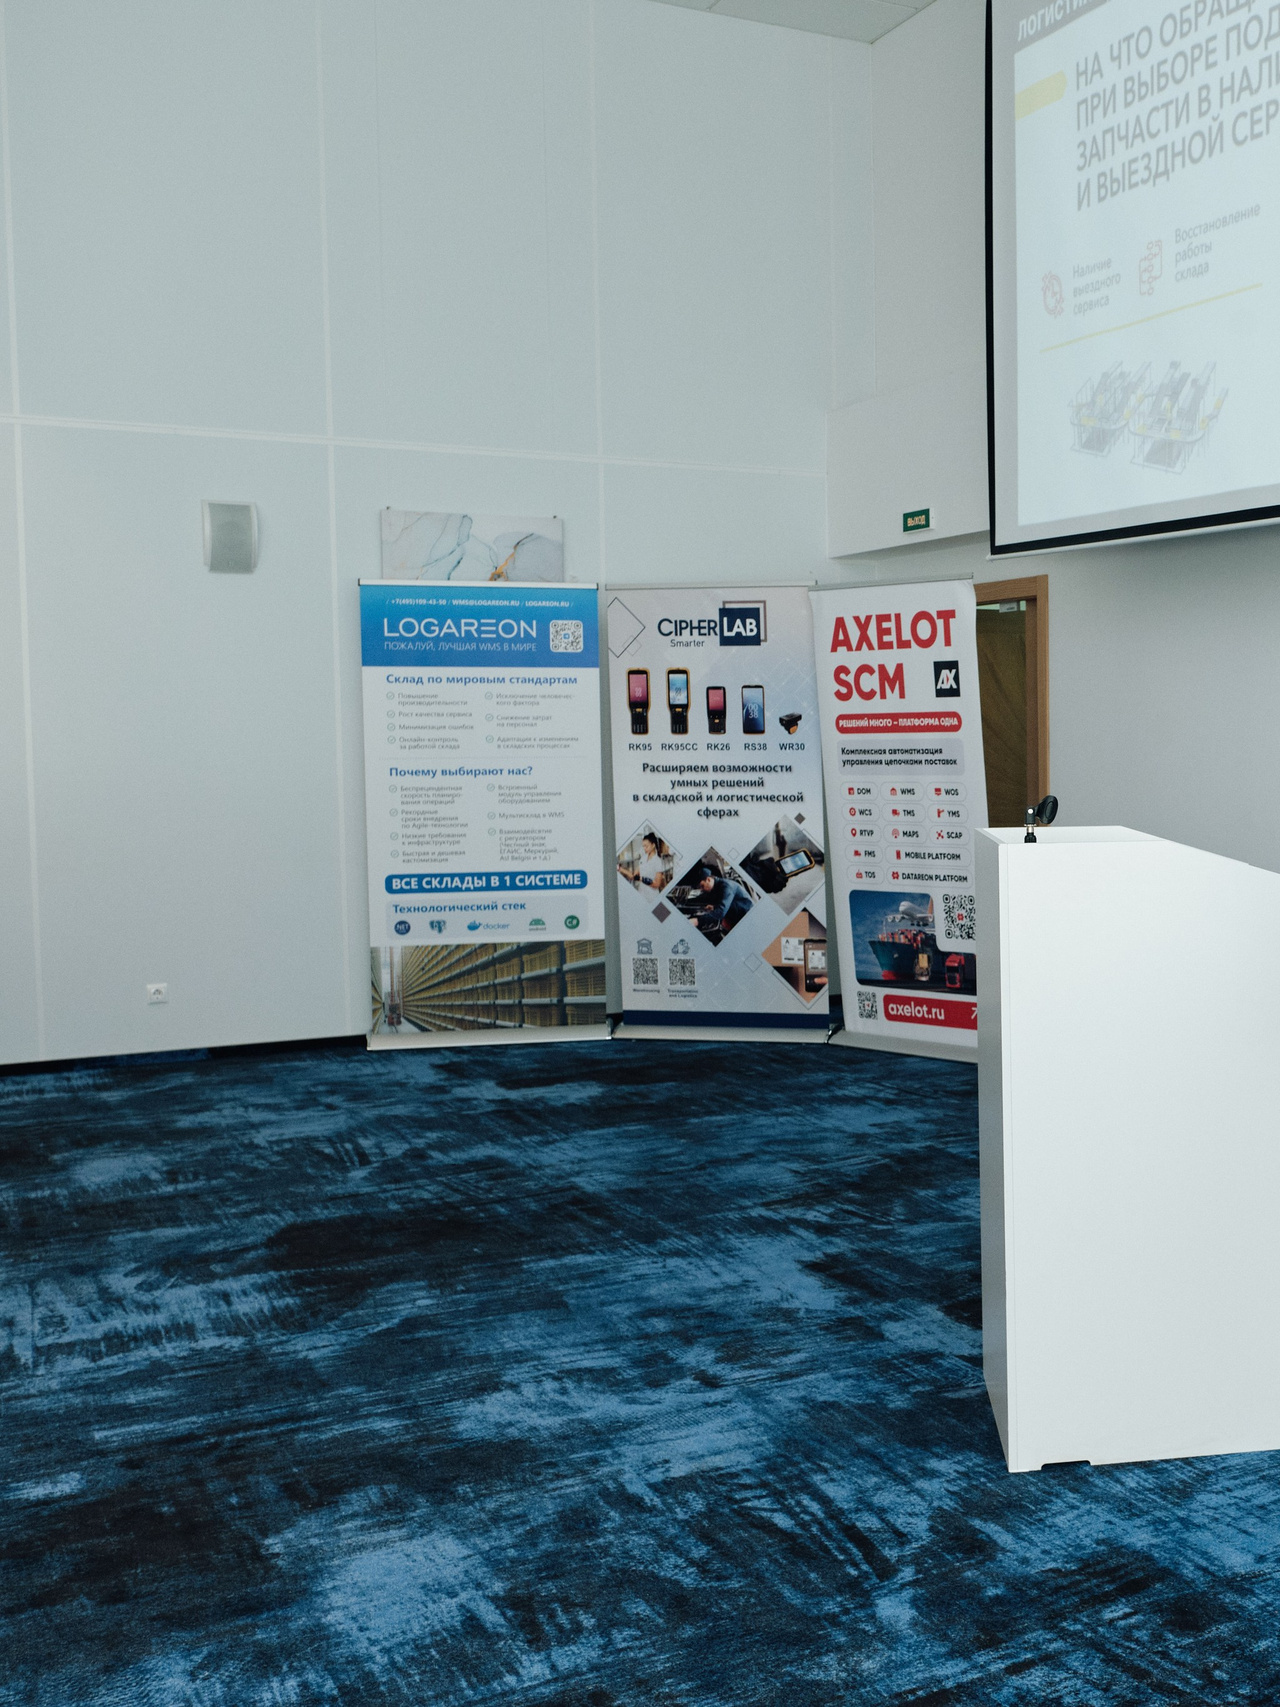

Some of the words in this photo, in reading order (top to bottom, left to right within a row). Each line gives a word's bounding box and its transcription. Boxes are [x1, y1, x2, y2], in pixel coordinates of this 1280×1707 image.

[1076, 52, 1104, 91] НА
[1109, 25, 1153, 71] ЧТО
[1076, 83, 1117, 131] ПРИ
[1123, 35, 1218, 108] ВЫБОРЕ
[1076, 92, 1190, 172] ЗАПЧАСТИ
[1198, 83, 1212, 119] В
[1076, 177, 1092, 212] И
[1097, 116, 1225, 203] ВЫЕЗДНОЙ
[1174, 203, 1261, 244] Восстановление
[1174, 240, 1213, 268] работы
[1072, 257, 1112, 279] Наличие
[1174, 261, 1209, 283] склада
[1073, 272, 1121, 299] выездного
[1073, 295, 1110, 316] сервиса
[383, 617, 537, 638] LOGAREON
[830, 609, 956, 653] AXELOT
[384, 641, 436, 652] ПОЖАЛУЙ,
[438, 642, 477, 651] ЛУЧШАЯ
[479, 642, 501, 651] WMS
[503, 643, 509, 651] В
[511, 642, 537, 652] МИРЕ
[670, 638, 705, 648] Smarter
[386, 673, 424, 686] Склад
[427, 676, 443, 684] по
[446, 676, 506, 686] мировым
[509, 676, 578, 686] стандартам
[833, 662, 906, 702] SCM
[839, 717, 869, 728] РЕШЕНИЙ
[869, 718, 892, 728] МНОГО
[898, 717, 940, 727] ПЛАТФОРМА
[940, 717, 958, 727] ОДНА
[628, 743, 652, 751] RK95
[661, 743, 698, 751] RK95CC
[706, 743, 731, 751] RK26
[744, 743, 767, 751] RS38
[779, 742, 806, 751] WR30
[841, 747, 886, 756] Комплексная
[888, 747, 943, 756] автоматизация
[842, 758, 883, 767] управления
[884, 757, 923, 767] цепочками
[924, 757, 958, 766] поставок
[389, 767, 437, 779] Почему
[441, 766, 504, 778] выбирают
[507, 766, 533, 776] нас?
[642, 763, 708, 774] Расширяем
[712, 764, 793, 773] возможности
[670, 779, 708, 790] умных
[711, 777, 765, 790] решений
[632, 794, 639, 802] в
[643, 792, 703, 804] складской
[706, 794, 713, 802] и
[716, 791, 804, 802] логистической
[857, 788, 871, 796] DOM
[900, 788, 915, 796] WMS
[944, 788, 959, 797] WOS
[697, 806, 740, 819] сферах
[858, 808, 872, 816] WCS
[903, 809, 915, 818] TMS
[947, 810, 961, 818] YMS
[902, 830, 919, 839] MAPS
[946, 831, 963, 840] SCAP
[864, 850, 876, 858] FMS
[904, 851, 927, 861] MOBILE
[927, 852, 961, 862] PLATFORM
[864, 871, 876, 879] TOS
[901, 873, 934, 882] DATAREON
[935, 874, 968, 884] PLATFORM
[392, 878, 418, 890] ВСЕ
[422, 876, 486, 890] СКЛАДЫ
[491, 876, 500, 887] В
[504, 875, 510, 887] 1
[515, 873, 581, 887] СИСТЕМЕ
[393, 901, 498, 914] Технологический
[501, 902, 526, 910] стек
[482, 921, 510, 930] docker
[888, 1001, 945, 1020] axelot.ru
